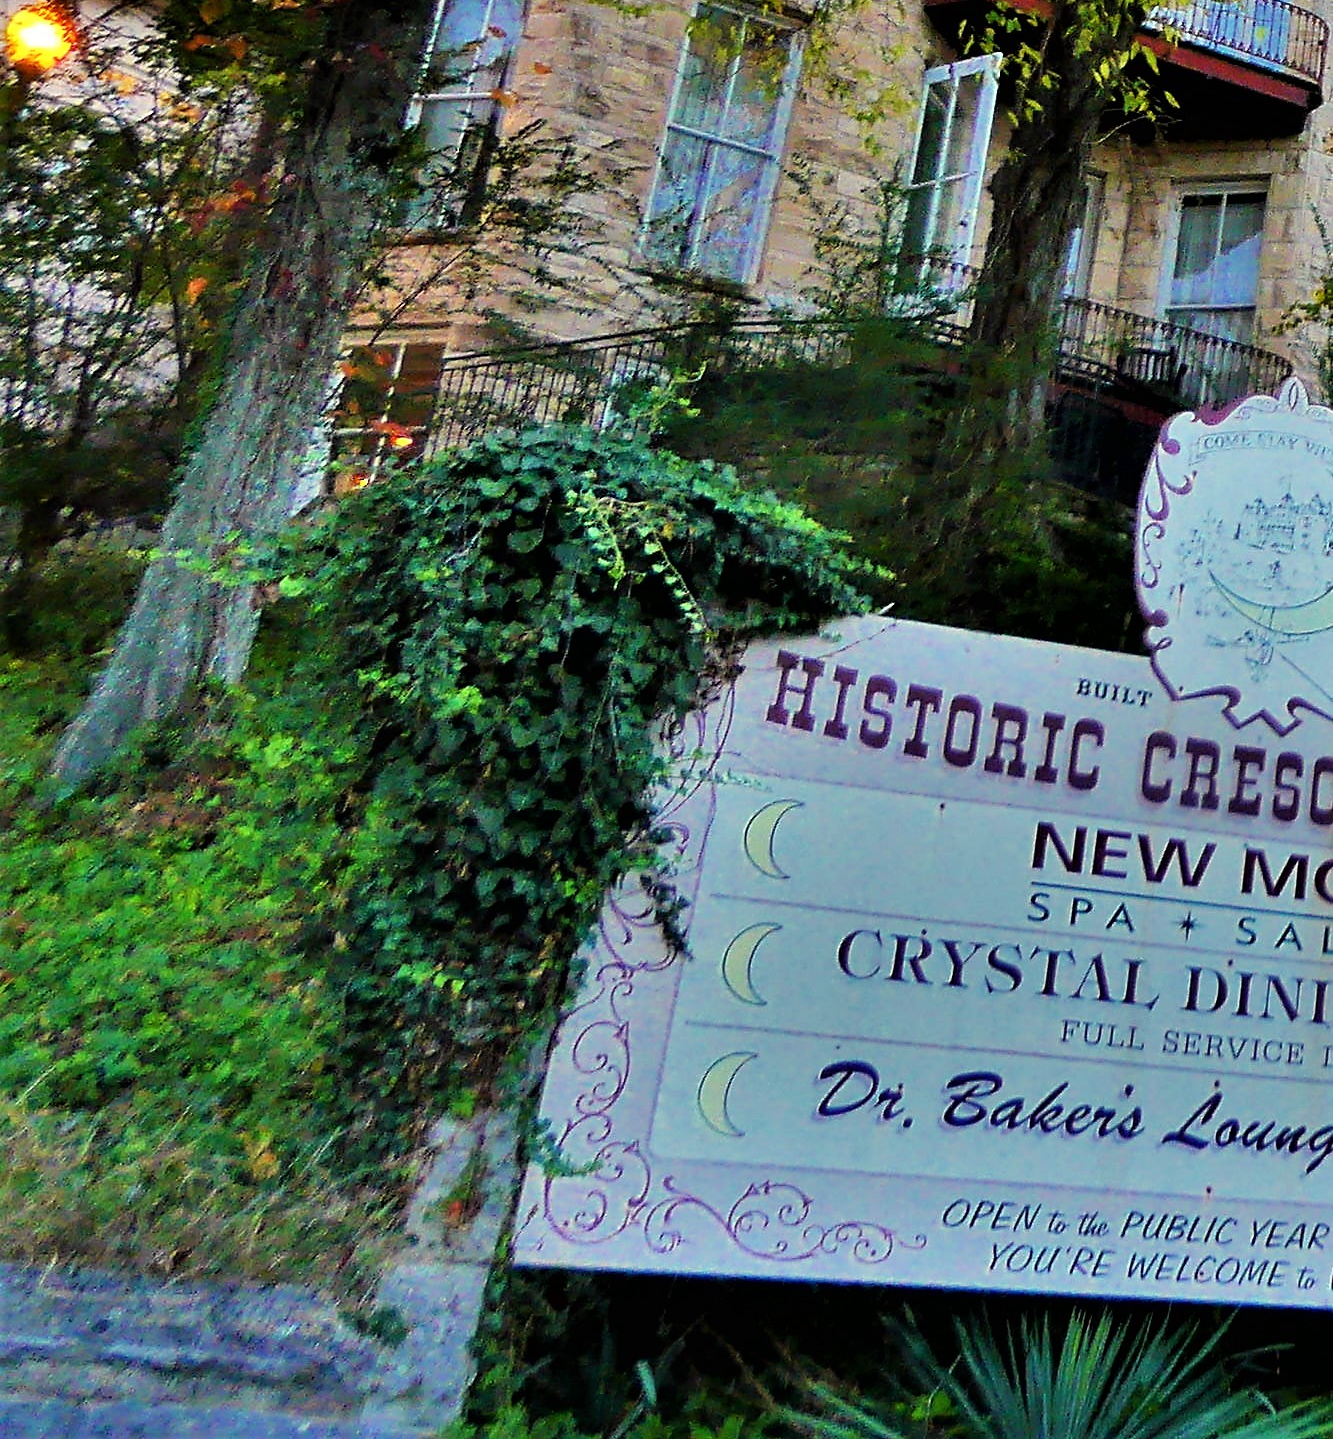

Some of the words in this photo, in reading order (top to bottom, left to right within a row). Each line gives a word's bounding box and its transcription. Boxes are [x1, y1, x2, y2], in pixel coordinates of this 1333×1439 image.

[1076, 677, 1153, 707] BUILT
[766, 649, 1105, 790] HISTORIC
[1031, 821, 1217, 887] NEW
[1027, 892, 1135, 933] SPA
[837, 928, 1160, 1011] CRYSTAL
[1060, 1019, 1145, 1051] FULL
[1161, 1029, 1304, 1065] SERVICE
[815, 1060, 914, 1129] Dr.
[941, 1070, 1146, 1141] Baker's
[941, 1198, 1042, 1232] OPEN
[1048, 1209, 1070, 1234] to
[1077, 1213, 1109, 1237] the
[1120, 1211, 1239, 1244] PUBLIC
[1251, 1219, 1330, 1251] YEAR
[985, 1242, 1115, 1277] YOU'RE
[1126, 1252, 1287, 1288] WELCOME
[1296, 1265, 1316, 1290] to
